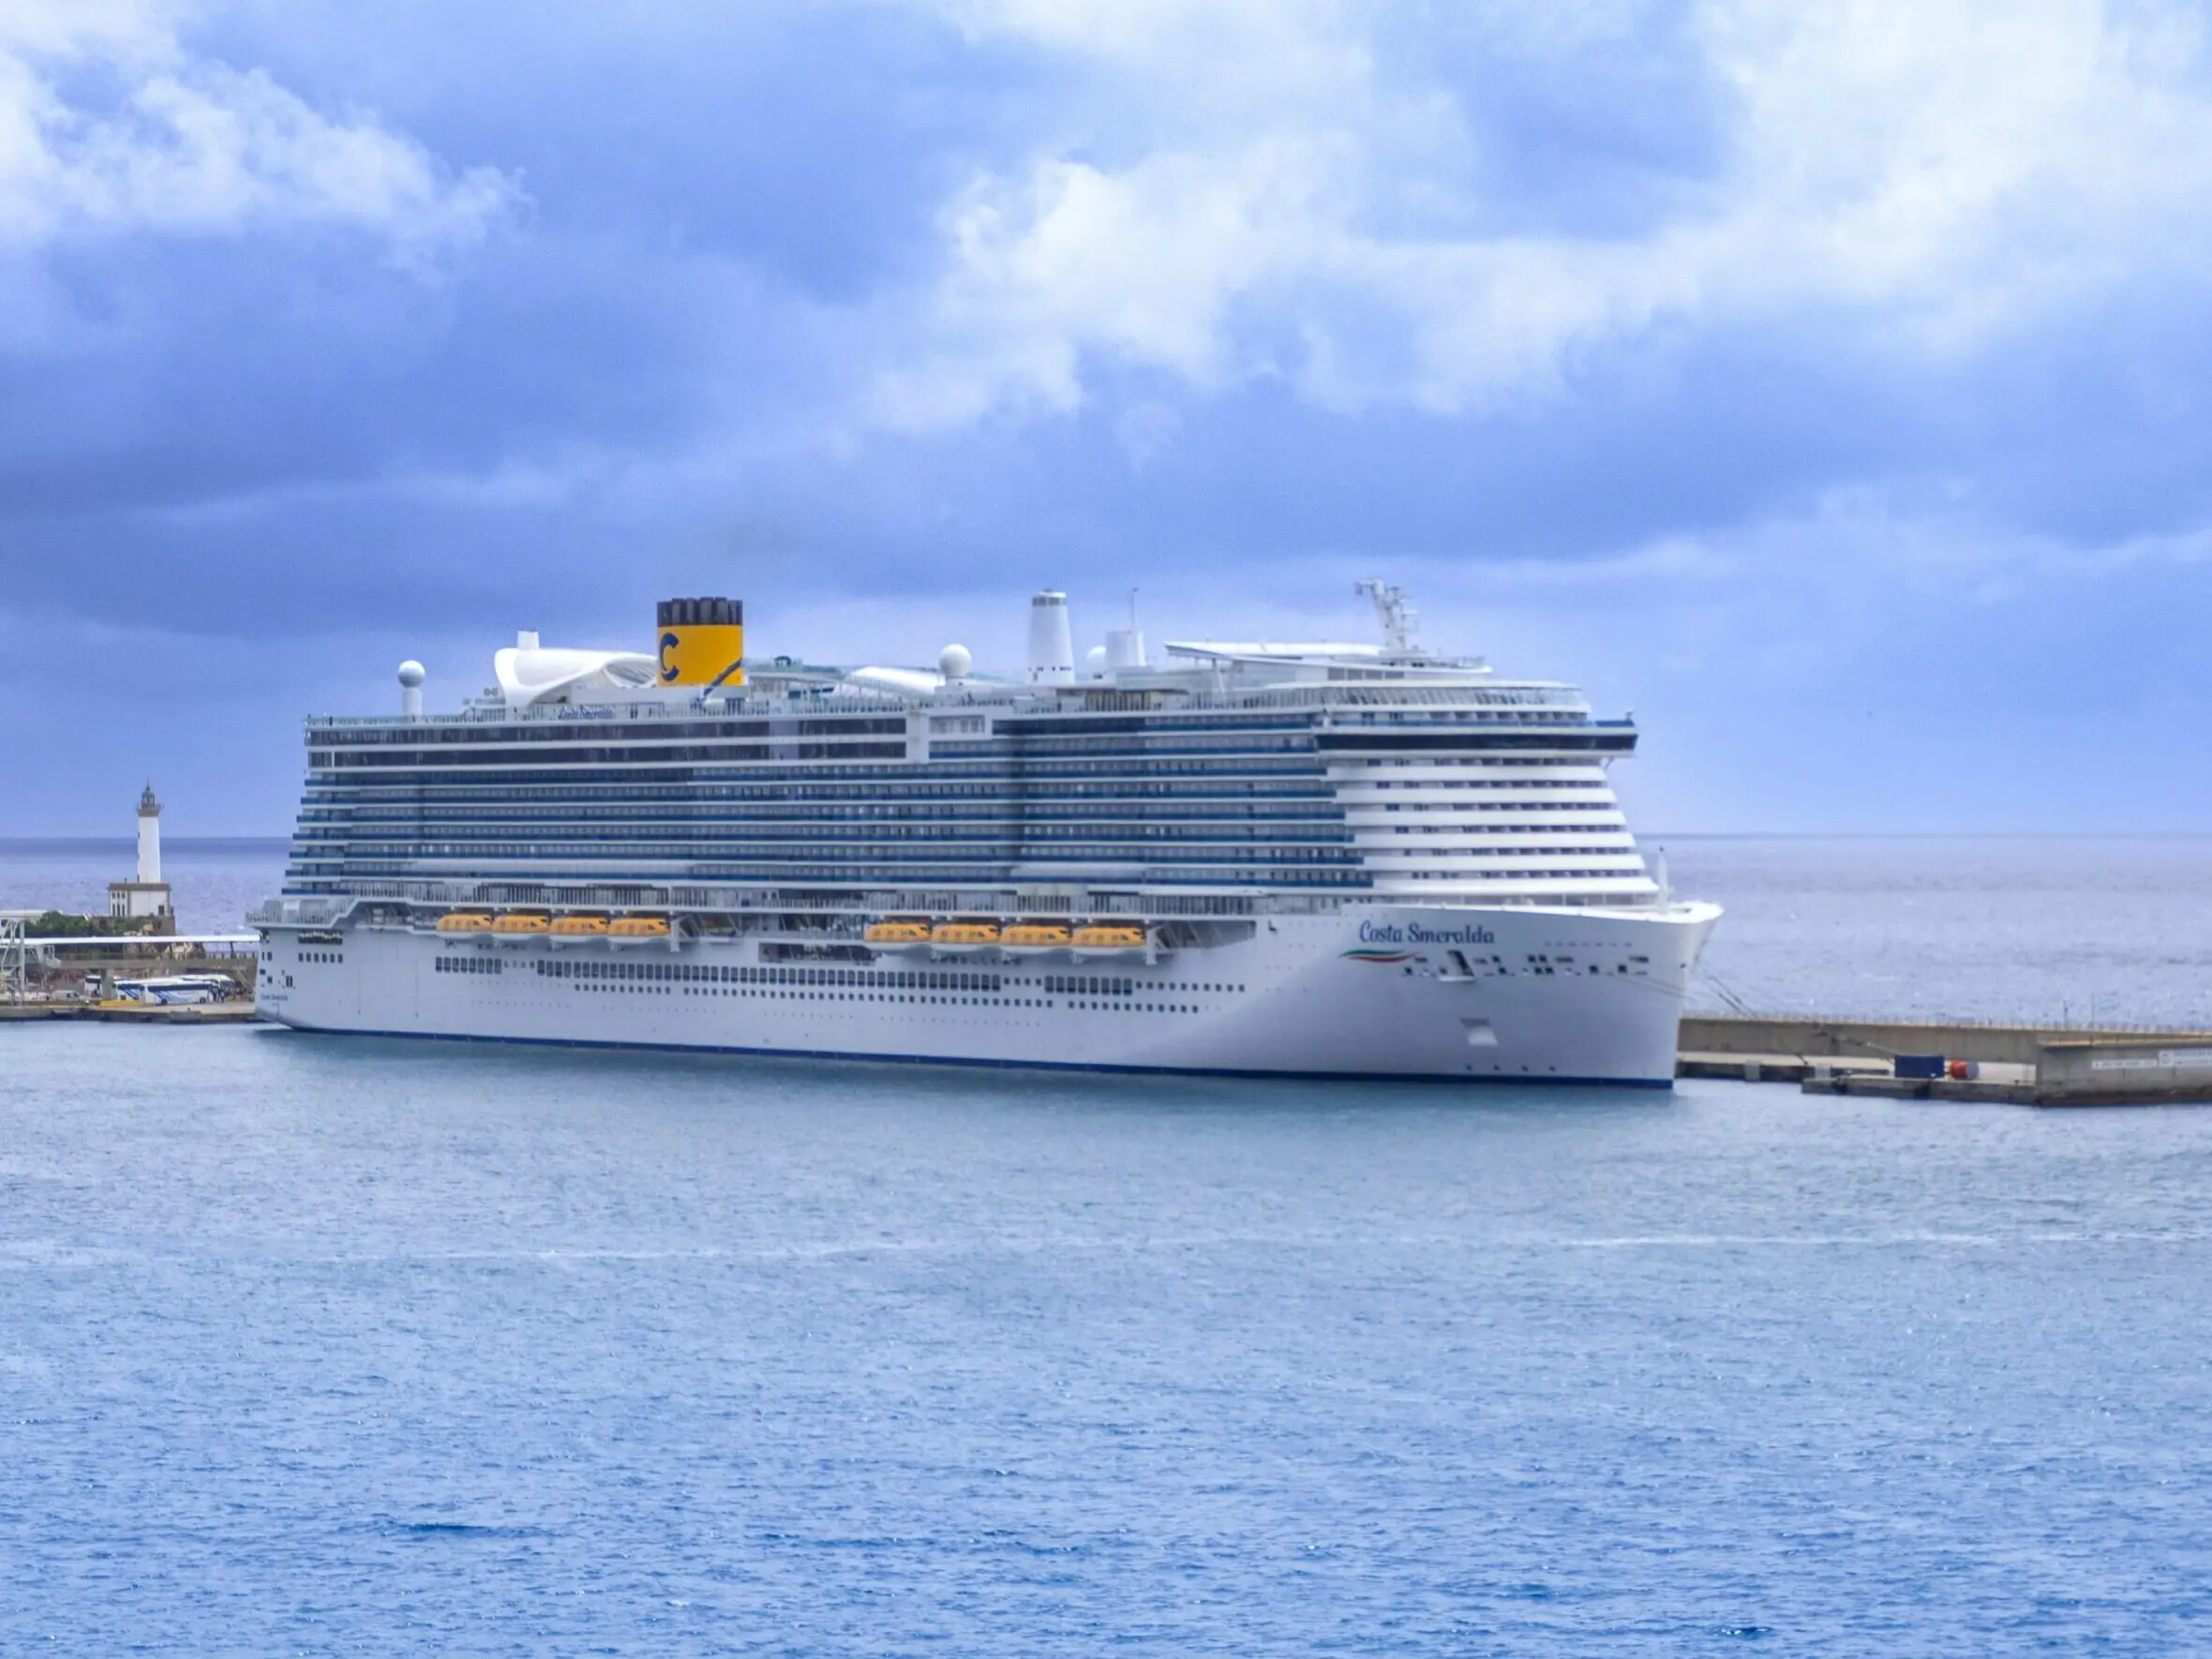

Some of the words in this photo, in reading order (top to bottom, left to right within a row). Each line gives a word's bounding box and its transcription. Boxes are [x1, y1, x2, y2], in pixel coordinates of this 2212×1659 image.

[660, 633, 680, 681] C
[1359, 919, 1402, 943] Costa
[1407, 922, 1495, 944] Smeralda
